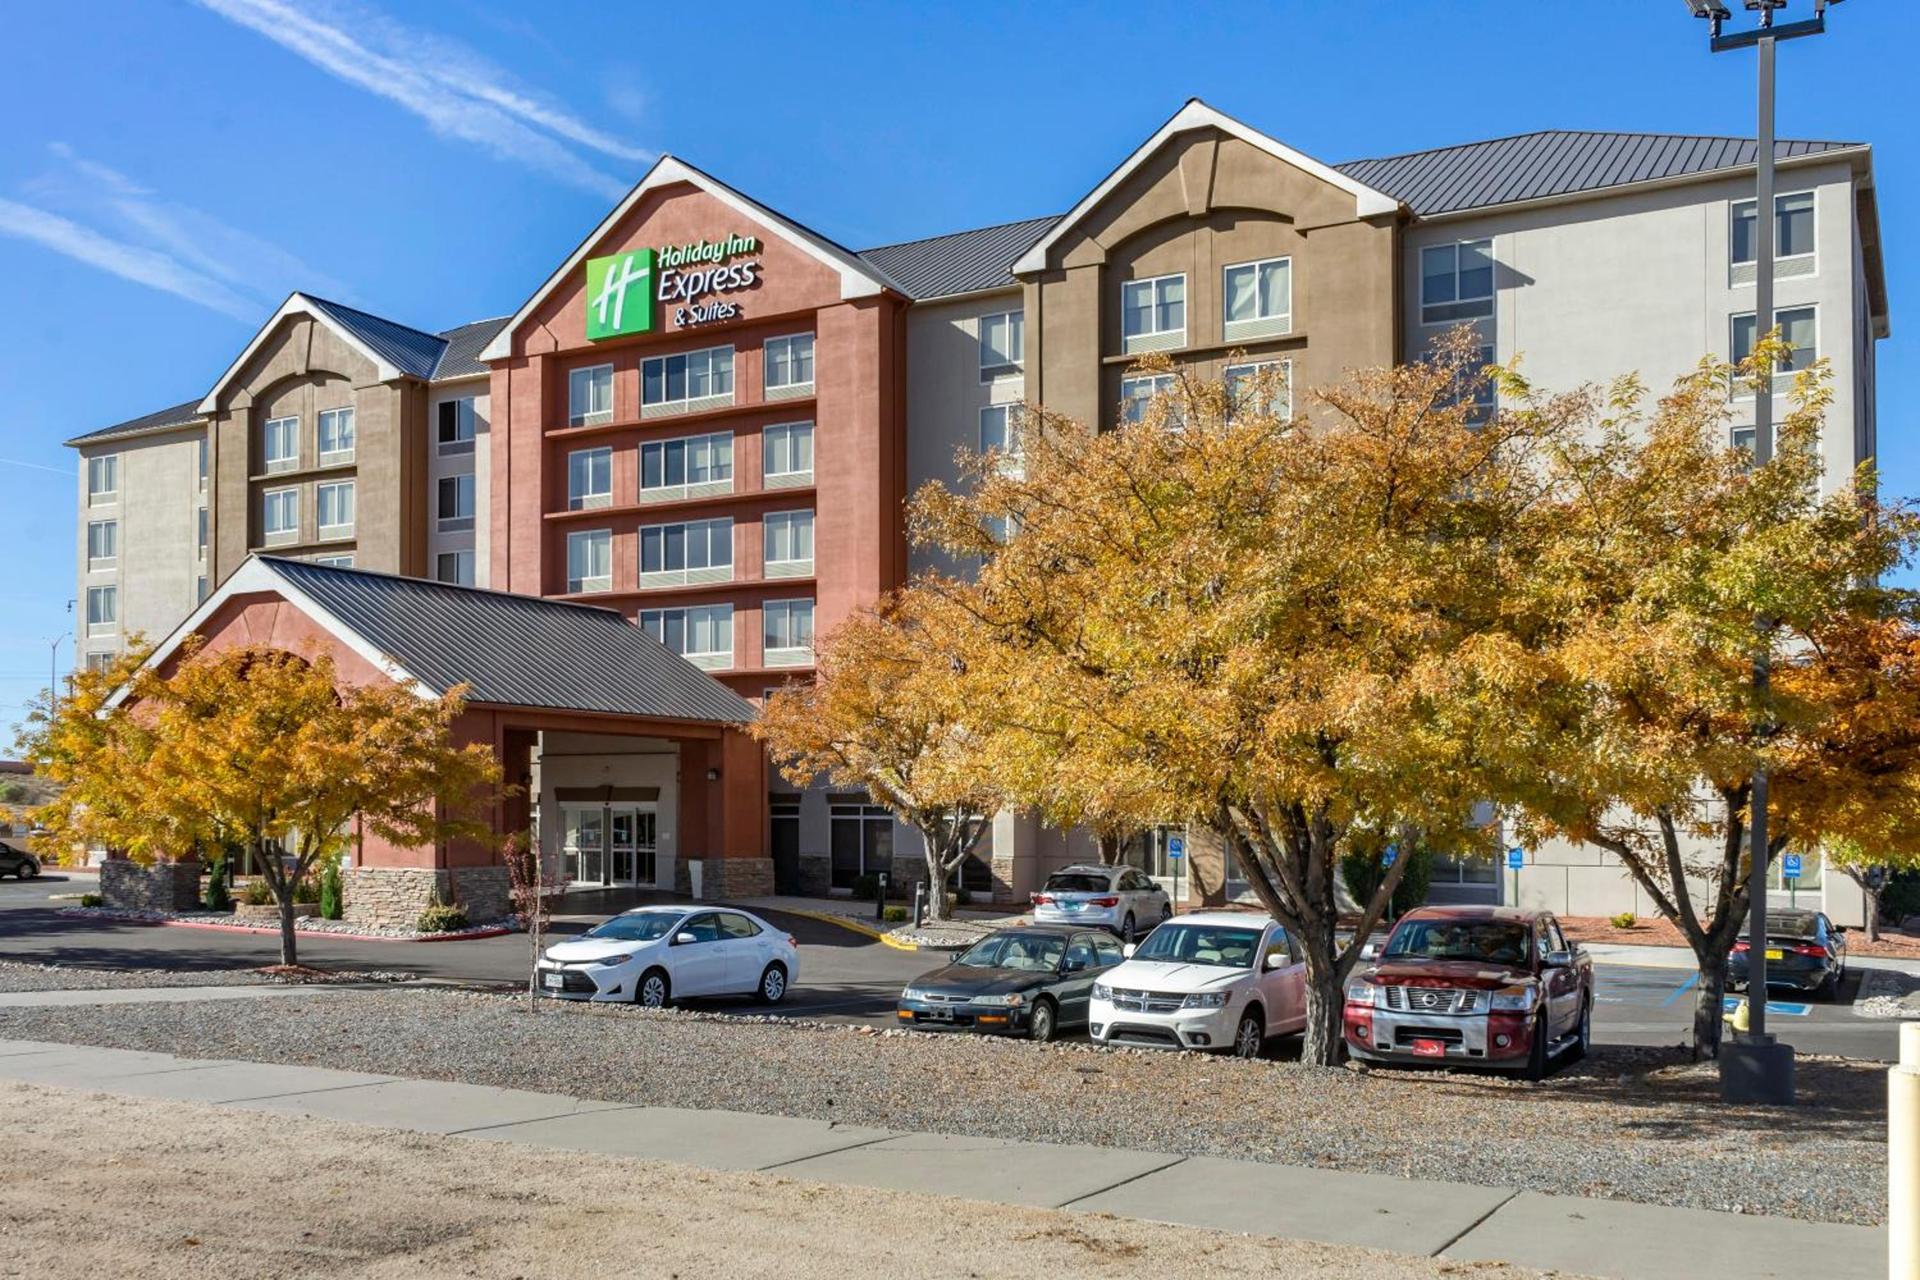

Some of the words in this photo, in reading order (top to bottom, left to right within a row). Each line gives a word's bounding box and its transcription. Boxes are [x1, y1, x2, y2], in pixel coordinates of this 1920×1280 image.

[657, 240, 723, 268] Holiday
[727, 233, 755, 255] Inn
[592, 256, 649, 329] H
[657, 261, 756, 303] Express
[674, 310, 685, 326] &
[688, 301, 736, 324] Suites
